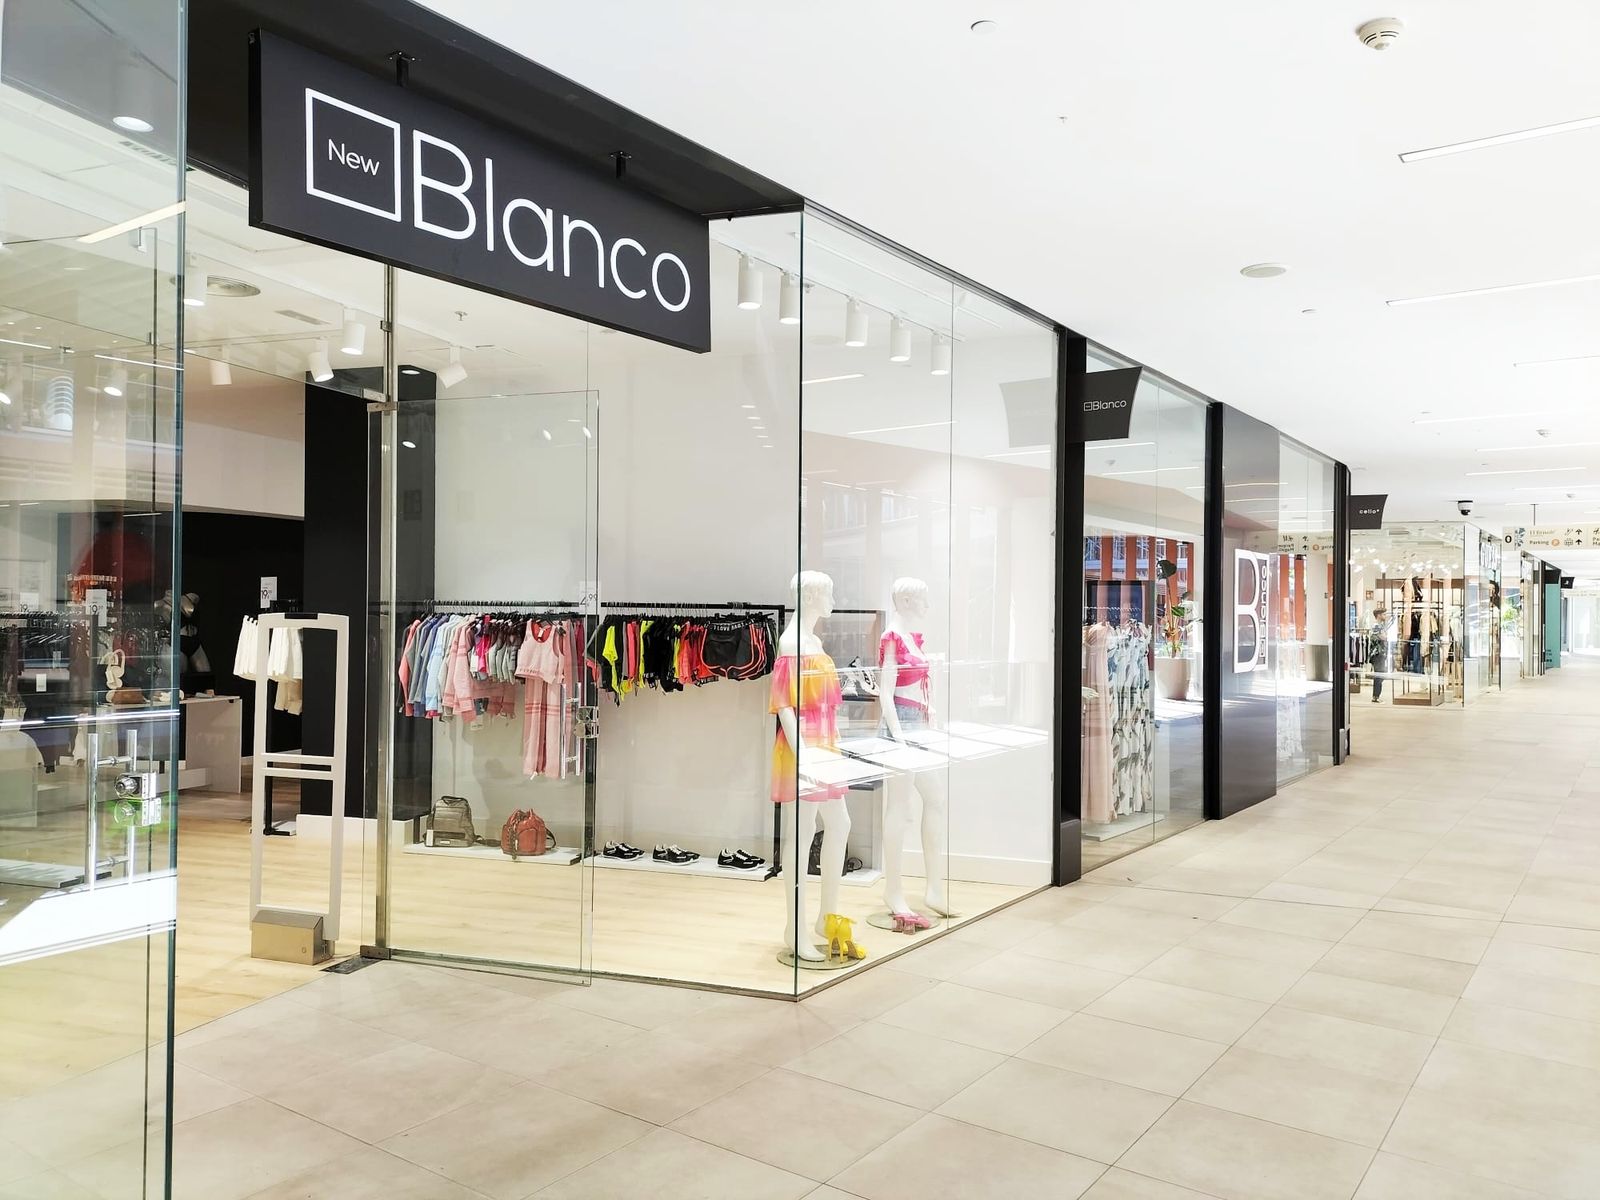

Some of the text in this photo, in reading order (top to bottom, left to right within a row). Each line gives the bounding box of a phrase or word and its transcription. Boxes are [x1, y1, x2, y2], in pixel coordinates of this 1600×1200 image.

[328, 129, 691, 312] New Blanco
[1092, 400, 1127, 411] Blanco
